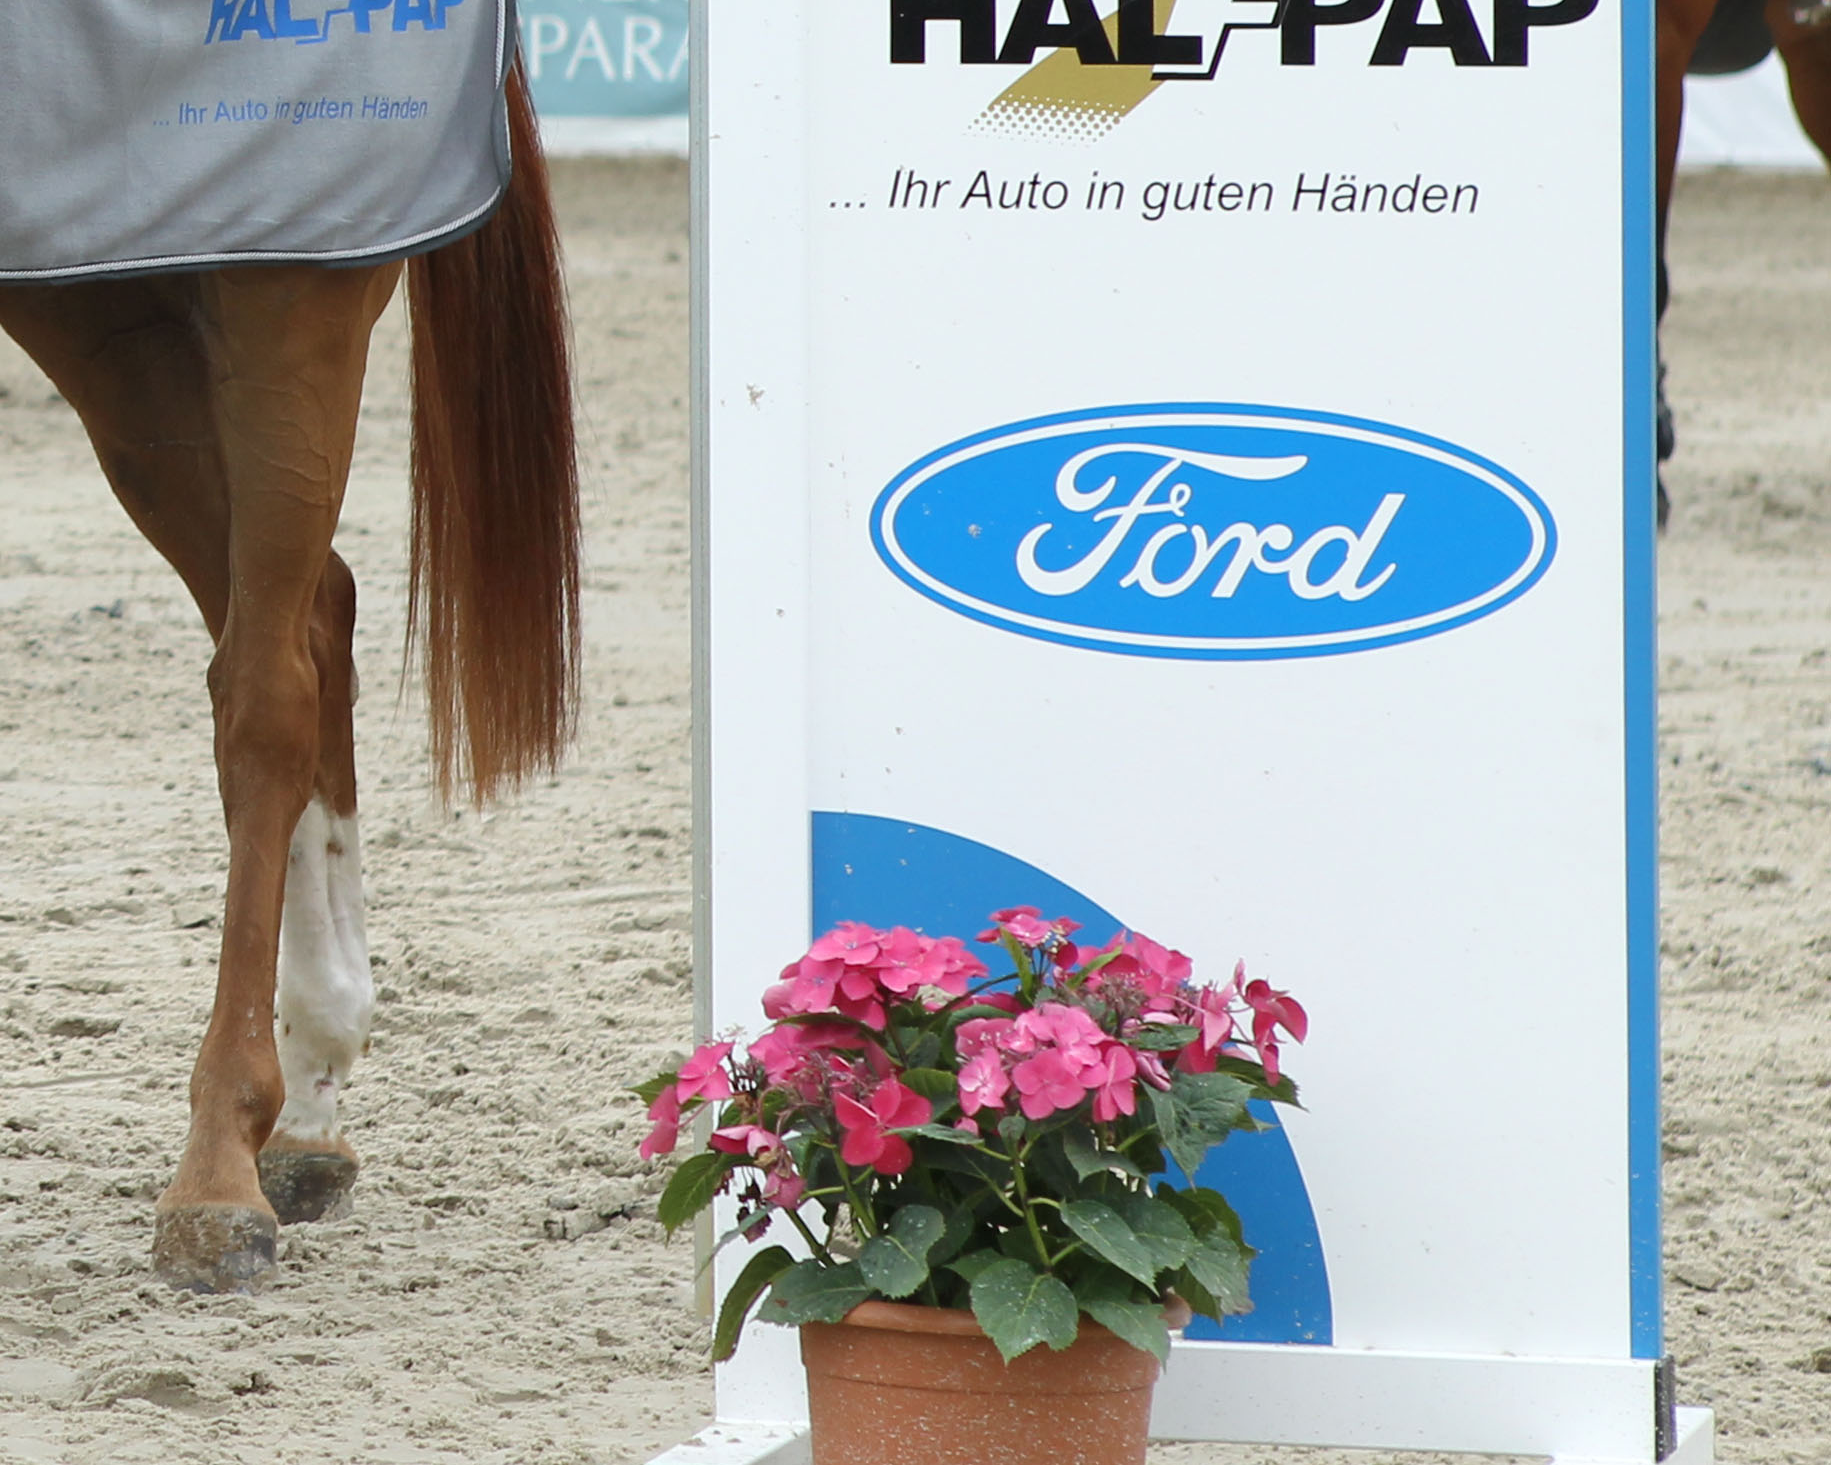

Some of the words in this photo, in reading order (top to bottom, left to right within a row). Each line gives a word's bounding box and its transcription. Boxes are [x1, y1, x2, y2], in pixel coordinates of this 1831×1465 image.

[178, 103, 206, 125] Ihr
[214, 99, 267, 124] Auto
[275, 97, 289, 119] in
[294, 97, 352, 124] guten
[362, 97, 428, 119] Händen
[888, 169, 951, 210] Ihr
[962, 170, 1069, 211] Auto
[1086, 172, 1123, 212] in
[1142, 176, 1273, 221] guten
[1291, 171, 1479, 214] Händen
[1016, 442, 1405, 602] Ford
